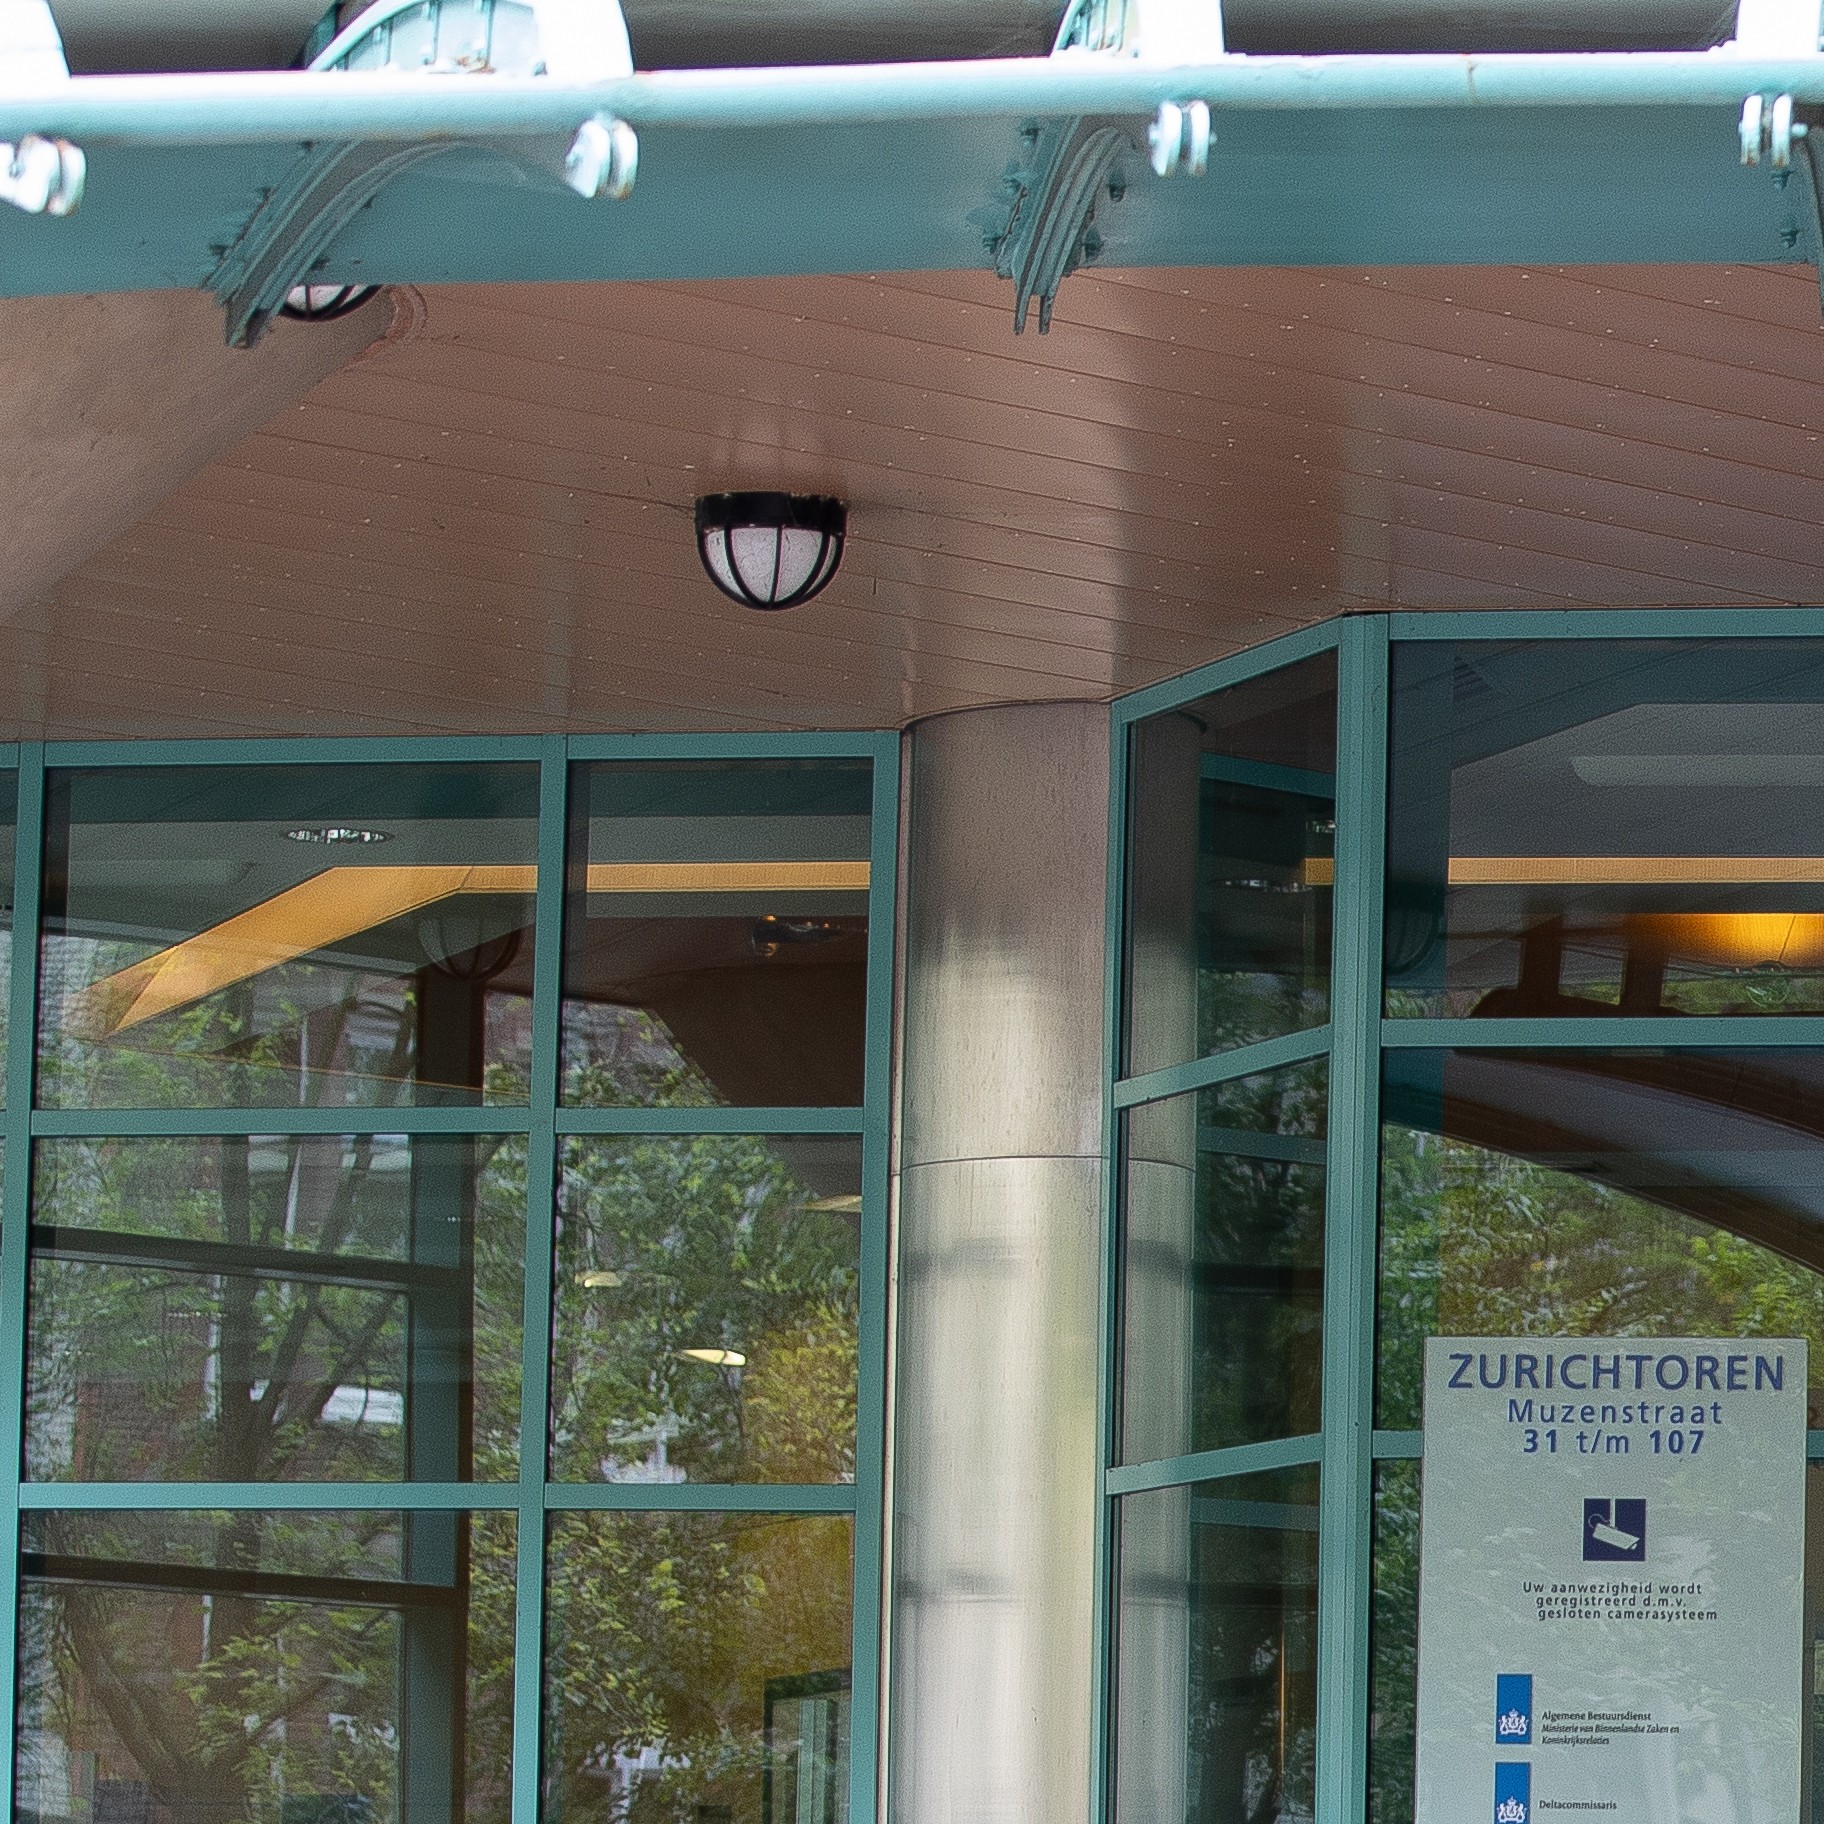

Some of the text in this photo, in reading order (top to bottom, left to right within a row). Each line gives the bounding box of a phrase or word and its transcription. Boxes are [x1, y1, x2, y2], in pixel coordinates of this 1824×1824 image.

[1447, 1353, 1784, 1391] ZURICHTOREN
[1507, 1398, 1722, 1425] Muzenstraat
[1523, 1428, 1704, 1455] 31 t/m 107
[1523, 1581, 1703, 1596] Uw aanwezigheid wordt
[1536, 1594, 1687, 1608] geregistreerd d.m.v.
[1538, 1607, 1718, 1623] gesloten camerasysteem
[1541, 1711, 1586, 1722] Algemene
[1539, 1799, 1617, 1810] Deltacommissaris
